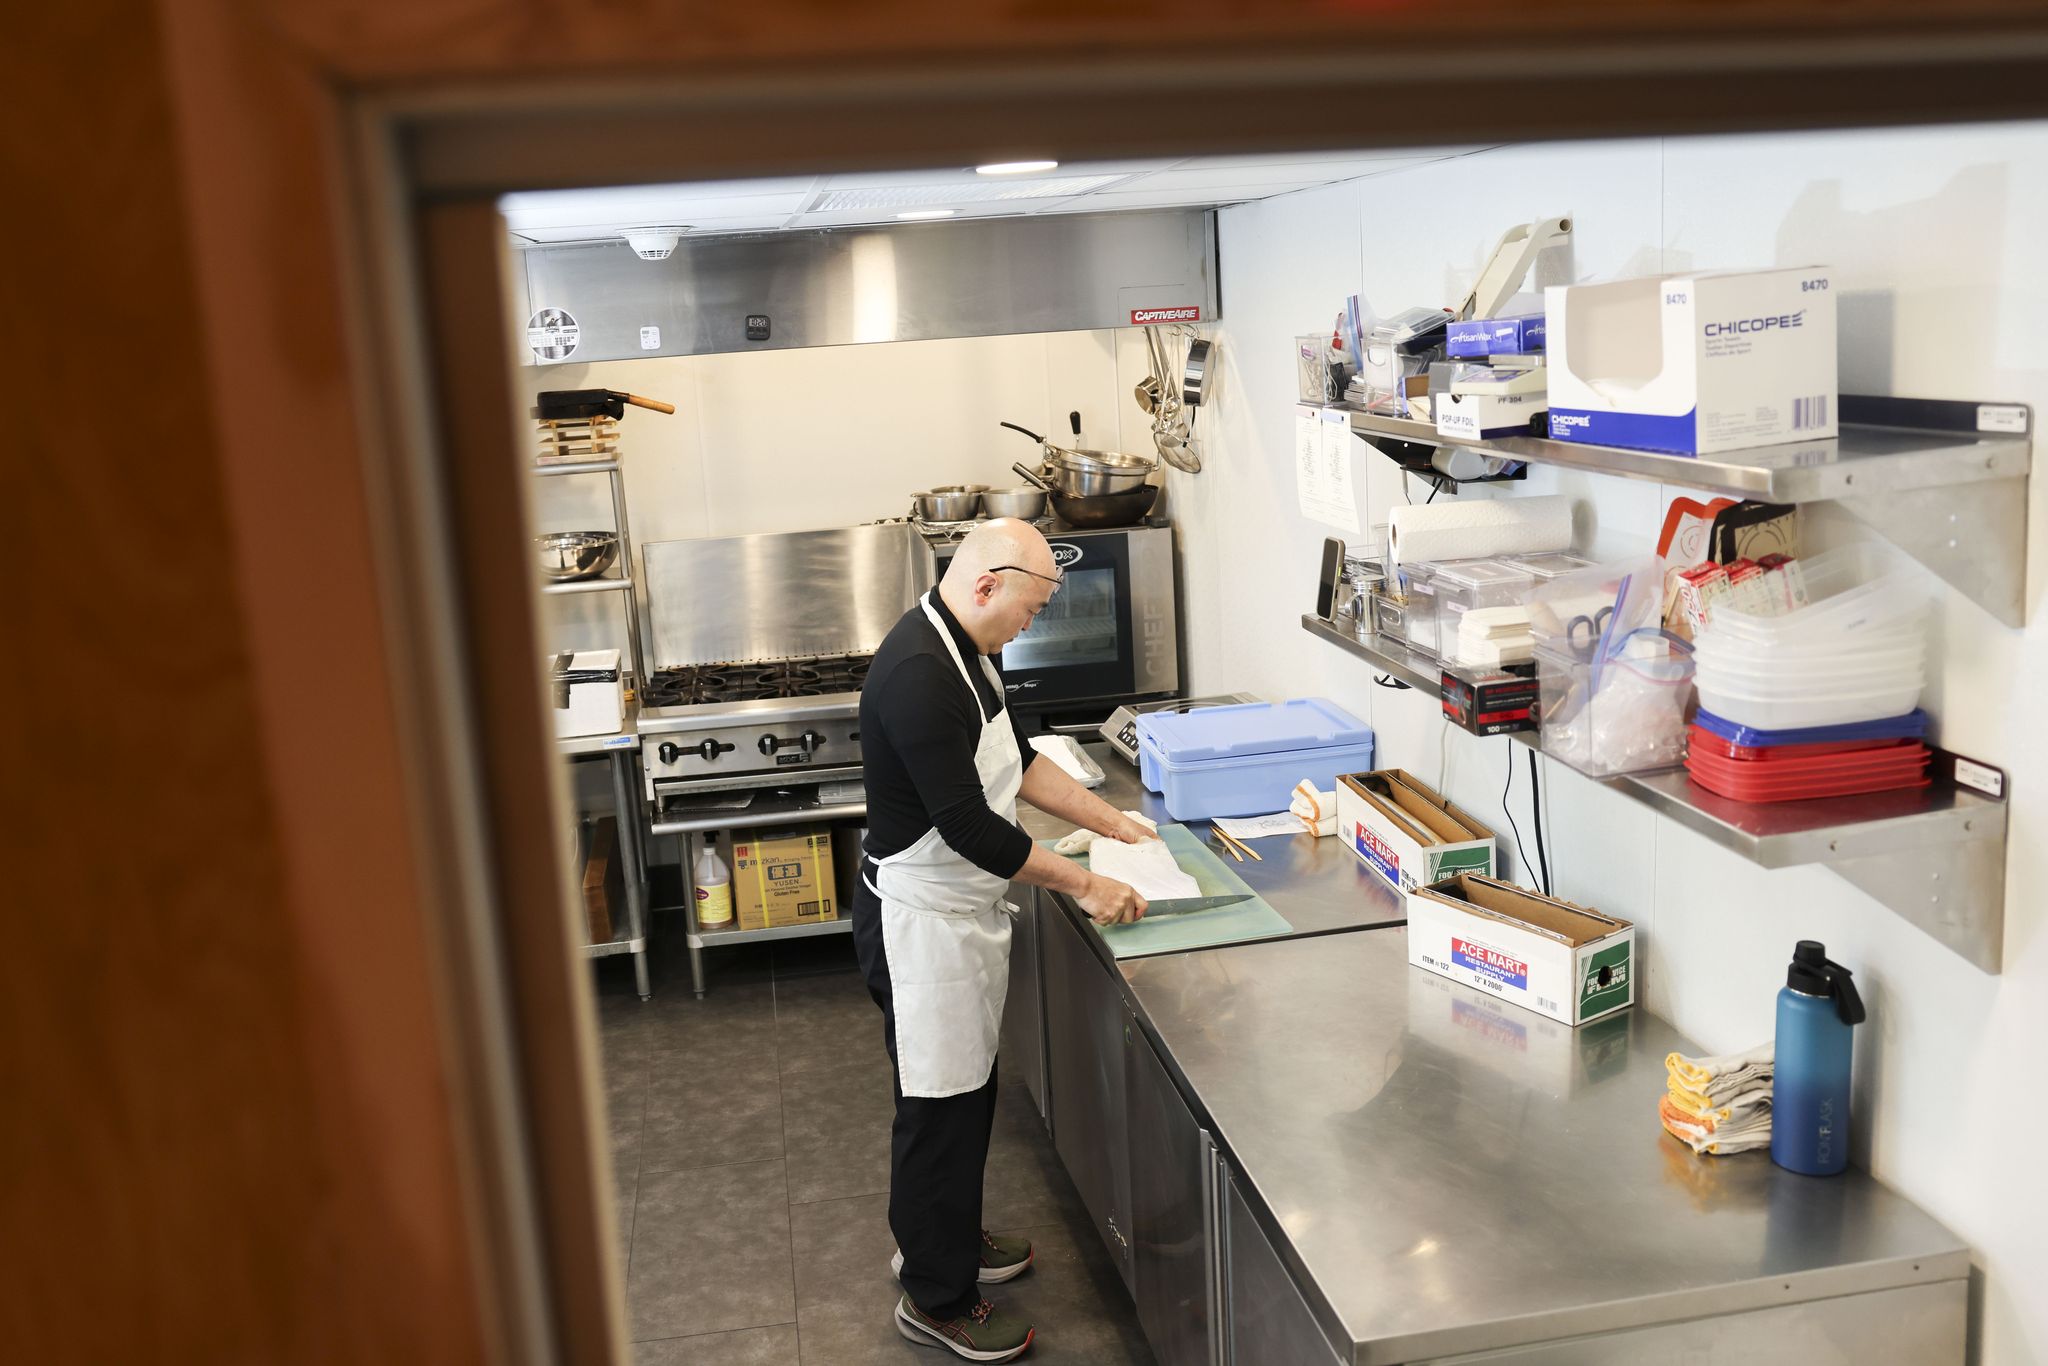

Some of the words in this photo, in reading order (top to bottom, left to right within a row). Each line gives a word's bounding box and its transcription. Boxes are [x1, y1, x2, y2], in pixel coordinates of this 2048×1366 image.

[1802, 279, 1828, 292] 8470
[1666, 294, 1687, 304] 8470
[1135, 309, 1197, 321] CAPTIVEAIRE
[1704, 311, 1803, 337] CHICOPEE
[1450, 331, 1491, 343] ArtisanWax
[1442, 413, 1460, 425] POP-UP
[1462, 415, 1474, 427] FOIL
[1551, 415, 1590, 427] CHICOPEE
[1053, 549, 1073, 560] OX
[1487, 725, 1500, 733] 100
[1361, 827, 1375, 848] ACE
[1375, 839, 1396, 866] MART
[750, 857, 780, 866] mzkan
[1363, 843, 1392, 872] RESTAURANT
[1438, 870, 1454, 879] FOO
[773, 879, 799, 887] YUSEN
[1422, 955, 1435, 965] ITEM
[1440, 962, 1449, 971] 122
[1459, 941, 1485, 960] ACE
[1487, 951, 1522, 974] MART
[1465, 956, 1516, 979] RESTAURANT
[1475, 966, 1505, 982] SUPPLY
